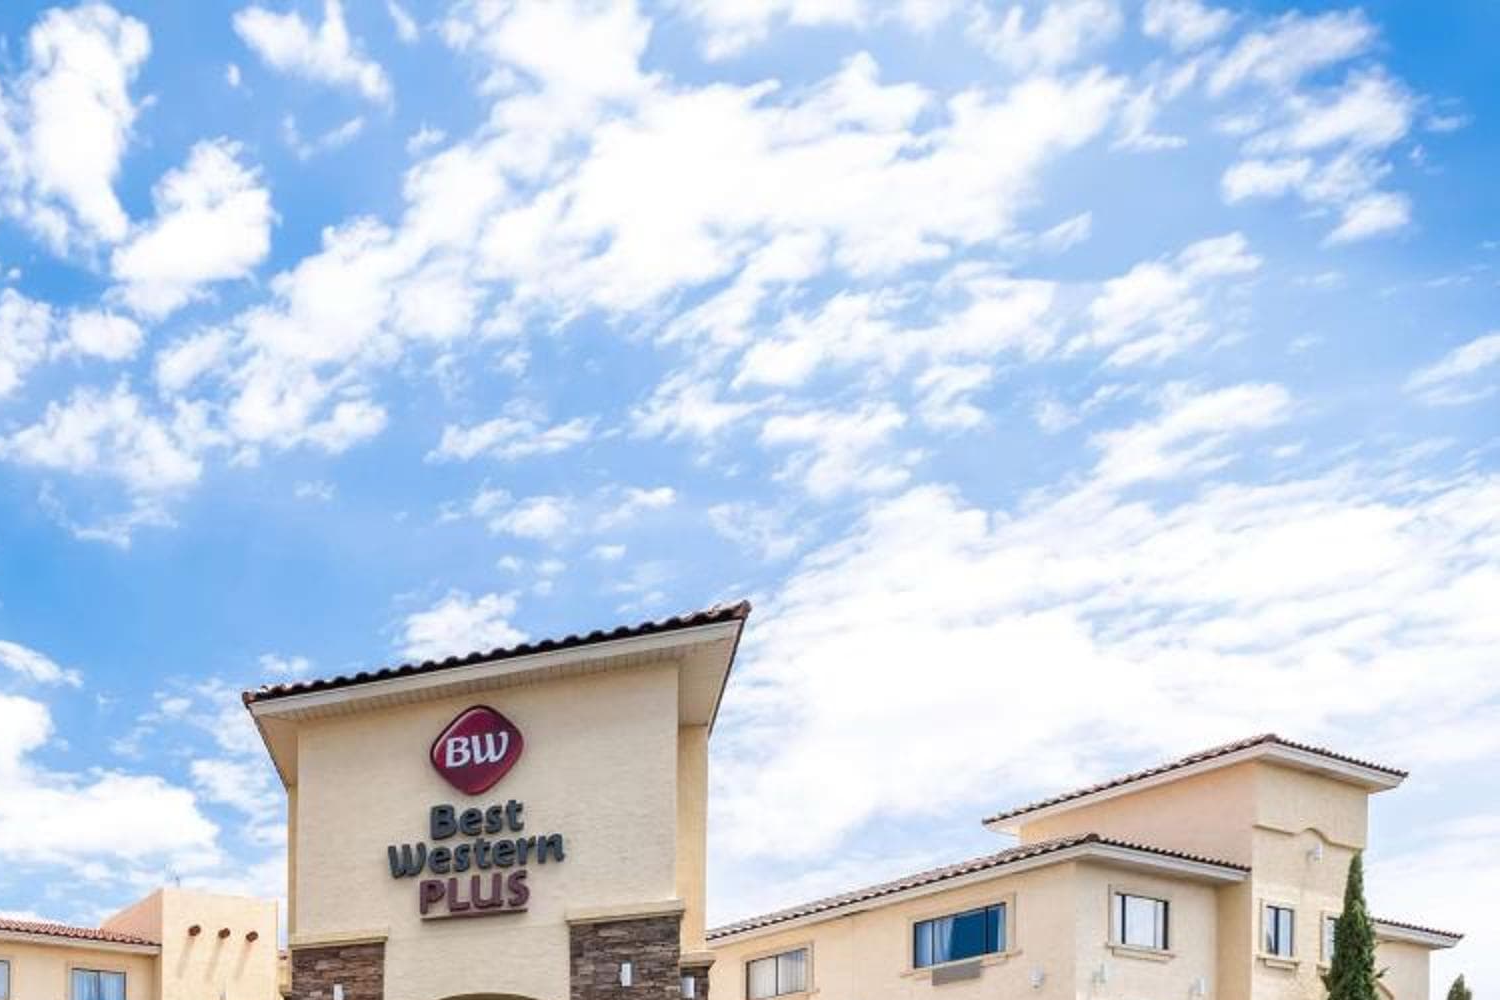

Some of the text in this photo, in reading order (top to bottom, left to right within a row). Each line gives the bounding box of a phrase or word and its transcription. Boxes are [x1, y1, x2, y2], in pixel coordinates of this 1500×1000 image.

[445, 730, 510, 768] BW
[430, 799, 524, 841] Best
[388, 832, 565, 879] Western
[419, 869, 530, 915] PLUS
